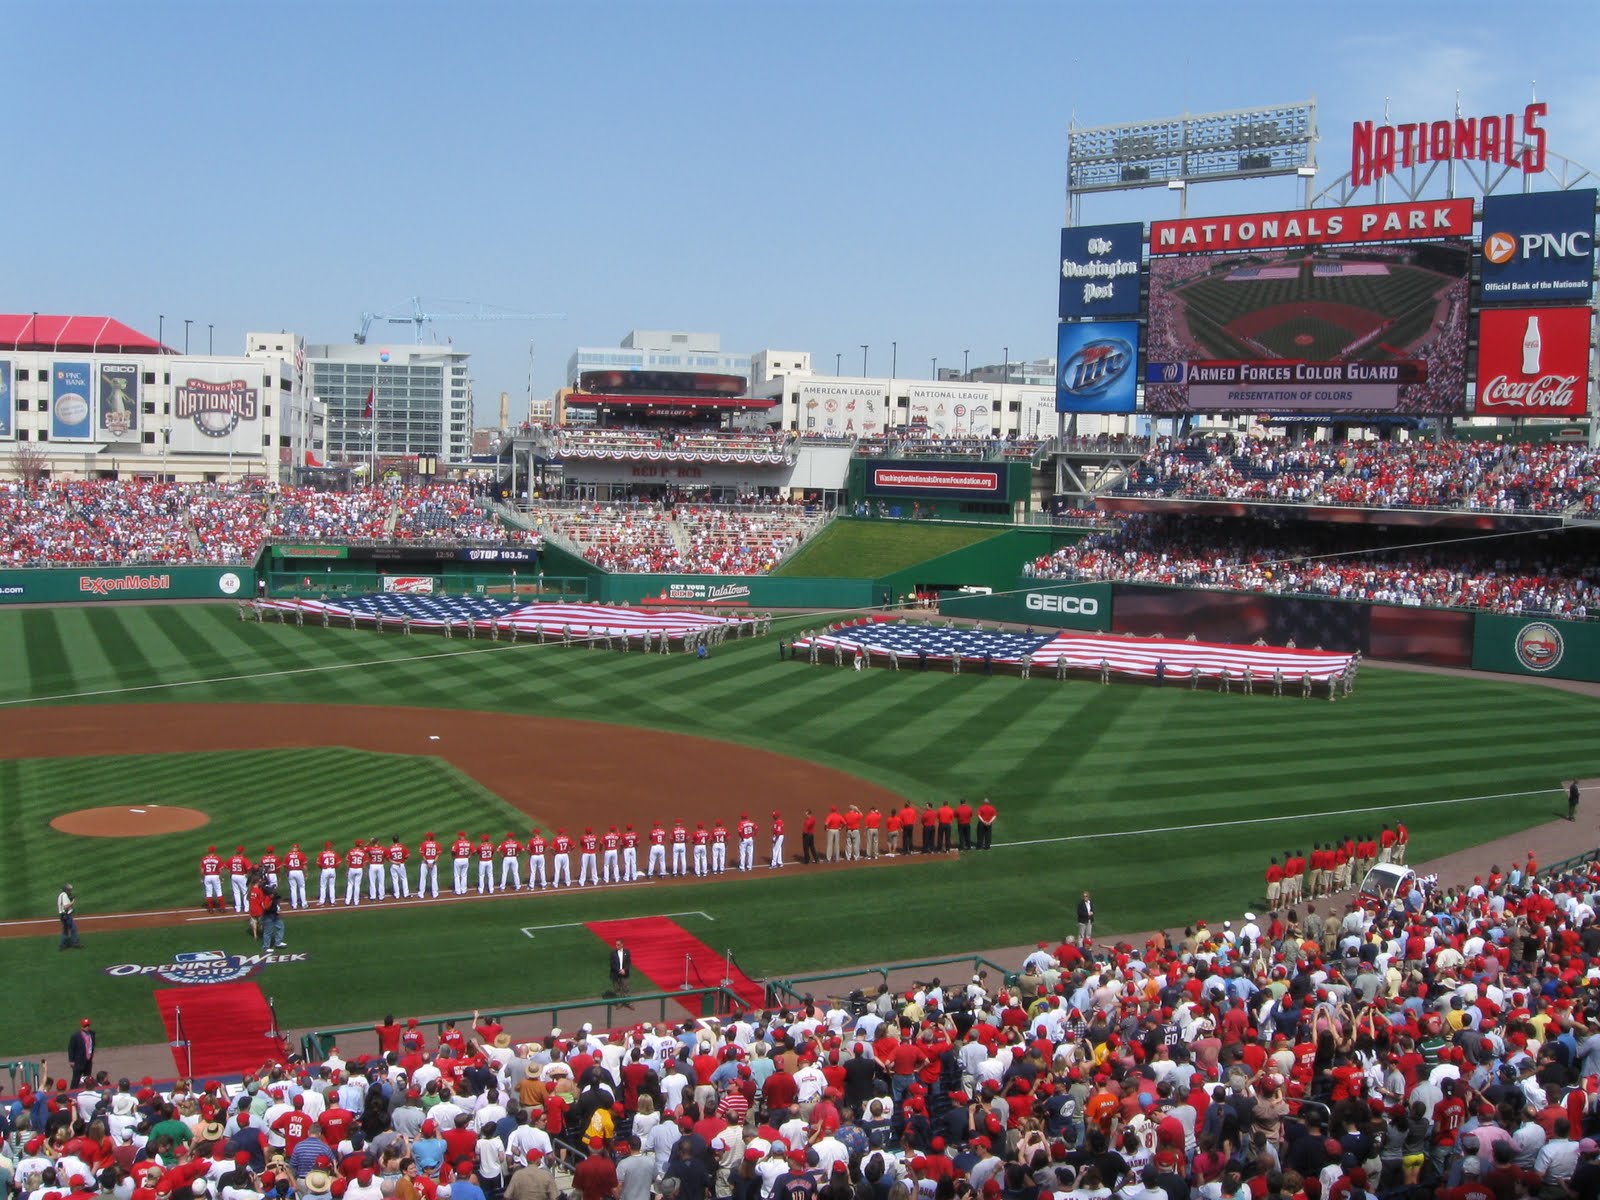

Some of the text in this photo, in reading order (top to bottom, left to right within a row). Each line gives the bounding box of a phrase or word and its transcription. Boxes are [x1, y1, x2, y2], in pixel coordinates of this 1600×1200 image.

[1352, 102, 1547, 187] NATIONALS
[1160, 208, 1451, 246] NATIONALS PARK
[1087, 238, 1113, 255] The
[1520, 231, 1590, 259] PNC
[1062, 258, 1138, 279] Washington
[1485, 279, 1589, 292] Official Bank of the Nationals
[1083, 282, 1114, 303] Post
[1188, 362, 1399, 381] ARMED FORCES COLOR GUARD
[190, 380, 243, 391] WASHINGTON
[1482, 374, 1581, 407] Coca-Cola
[804, 387, 881, 396] AMERICAN LEAGUE
[914, 390, 989, 400] NATIONAL LEAGUE
[1228, 391, 1353, 401] PRESENTATION OF COLORS
[179, 389, 254, 417] NATIONALS
[632, 466, 657, 477] RED
[879, 474, 992, 487] WashingtonNationalsDreamFoundation.org
[80, 575, 170, 594] ExxonMobil
[670, 589, 694, 598] RED
[1026, 593, 1098, 615] GEICO
[607, 839, 616, 848] 12
[628, 840, 634, 848] 3
[657, 835, 662, 843] 8
[700, 836, 706, 844] 4
[716, 835, 724, 843] 14
[458, 847, 470, 855] 25
[534, 845, 544, 853] 18
[559, 842, 568, 851] 17
[586, 842, 595, 850] 15
[391, 852, 403, 860] 32
[425, 848, 436, 856] 28
[481, 850, 492, 859] 23
[506, 848, 516, 856] 21
[288, 859, 300, 867] 49
[323, 857, 335, 866] 43
[351, 856, 362, 865] 36
[371, 854, 383, 863] 35
[205, 863, 216, 872] 57
[231, 863, 243, 872] 55
[104, 952, 309, 976] OPENING WEEK
[184, 967, 231, 978] 2010
[1164, 1033, 1178, 1046] 60
[1449, 1114, 1458, 1130] 11
[1144, 1132, 1153, 1149] 8
